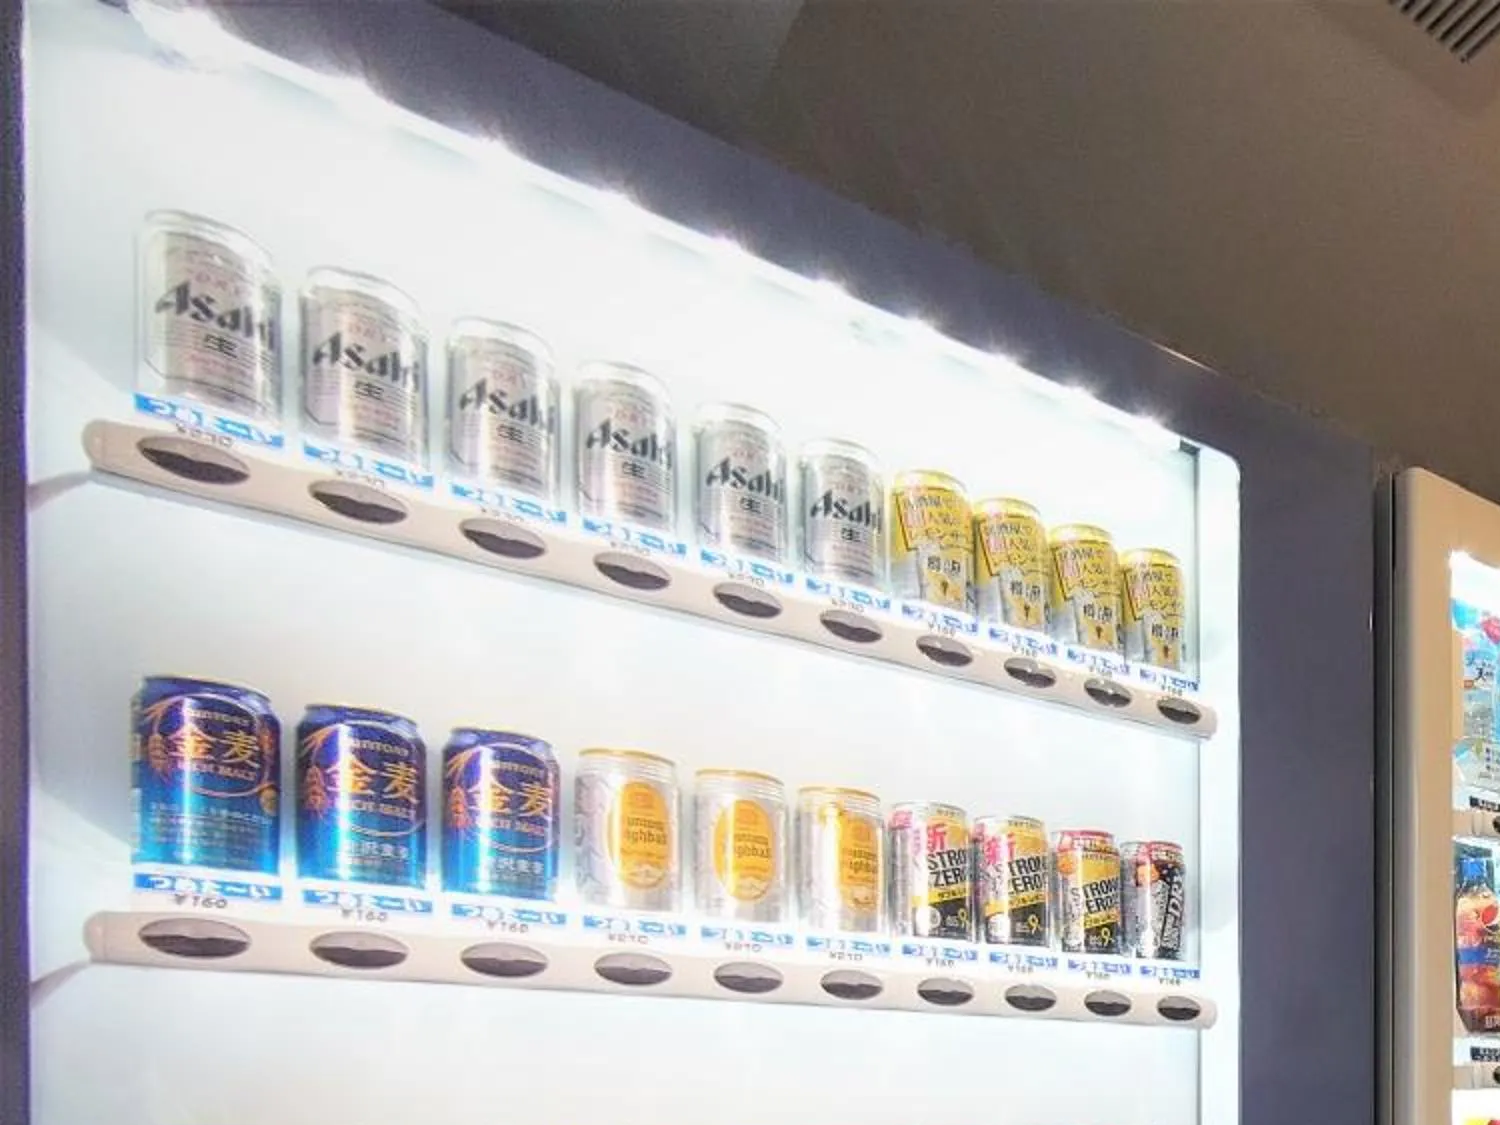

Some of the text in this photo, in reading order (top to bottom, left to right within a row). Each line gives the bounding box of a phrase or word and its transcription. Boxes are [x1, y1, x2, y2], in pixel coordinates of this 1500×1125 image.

[155, 281, 274, 350] Asahi
[313, 331, 419, 392] Asahi
[706, 457, 784, 505] Asahi
[811, 489, 881, 534] Asahi
[168, 717, 260, 770] 金麦
[174, 893, 228, 909] ¥160
[341, 908, 388, 923] ¥160
